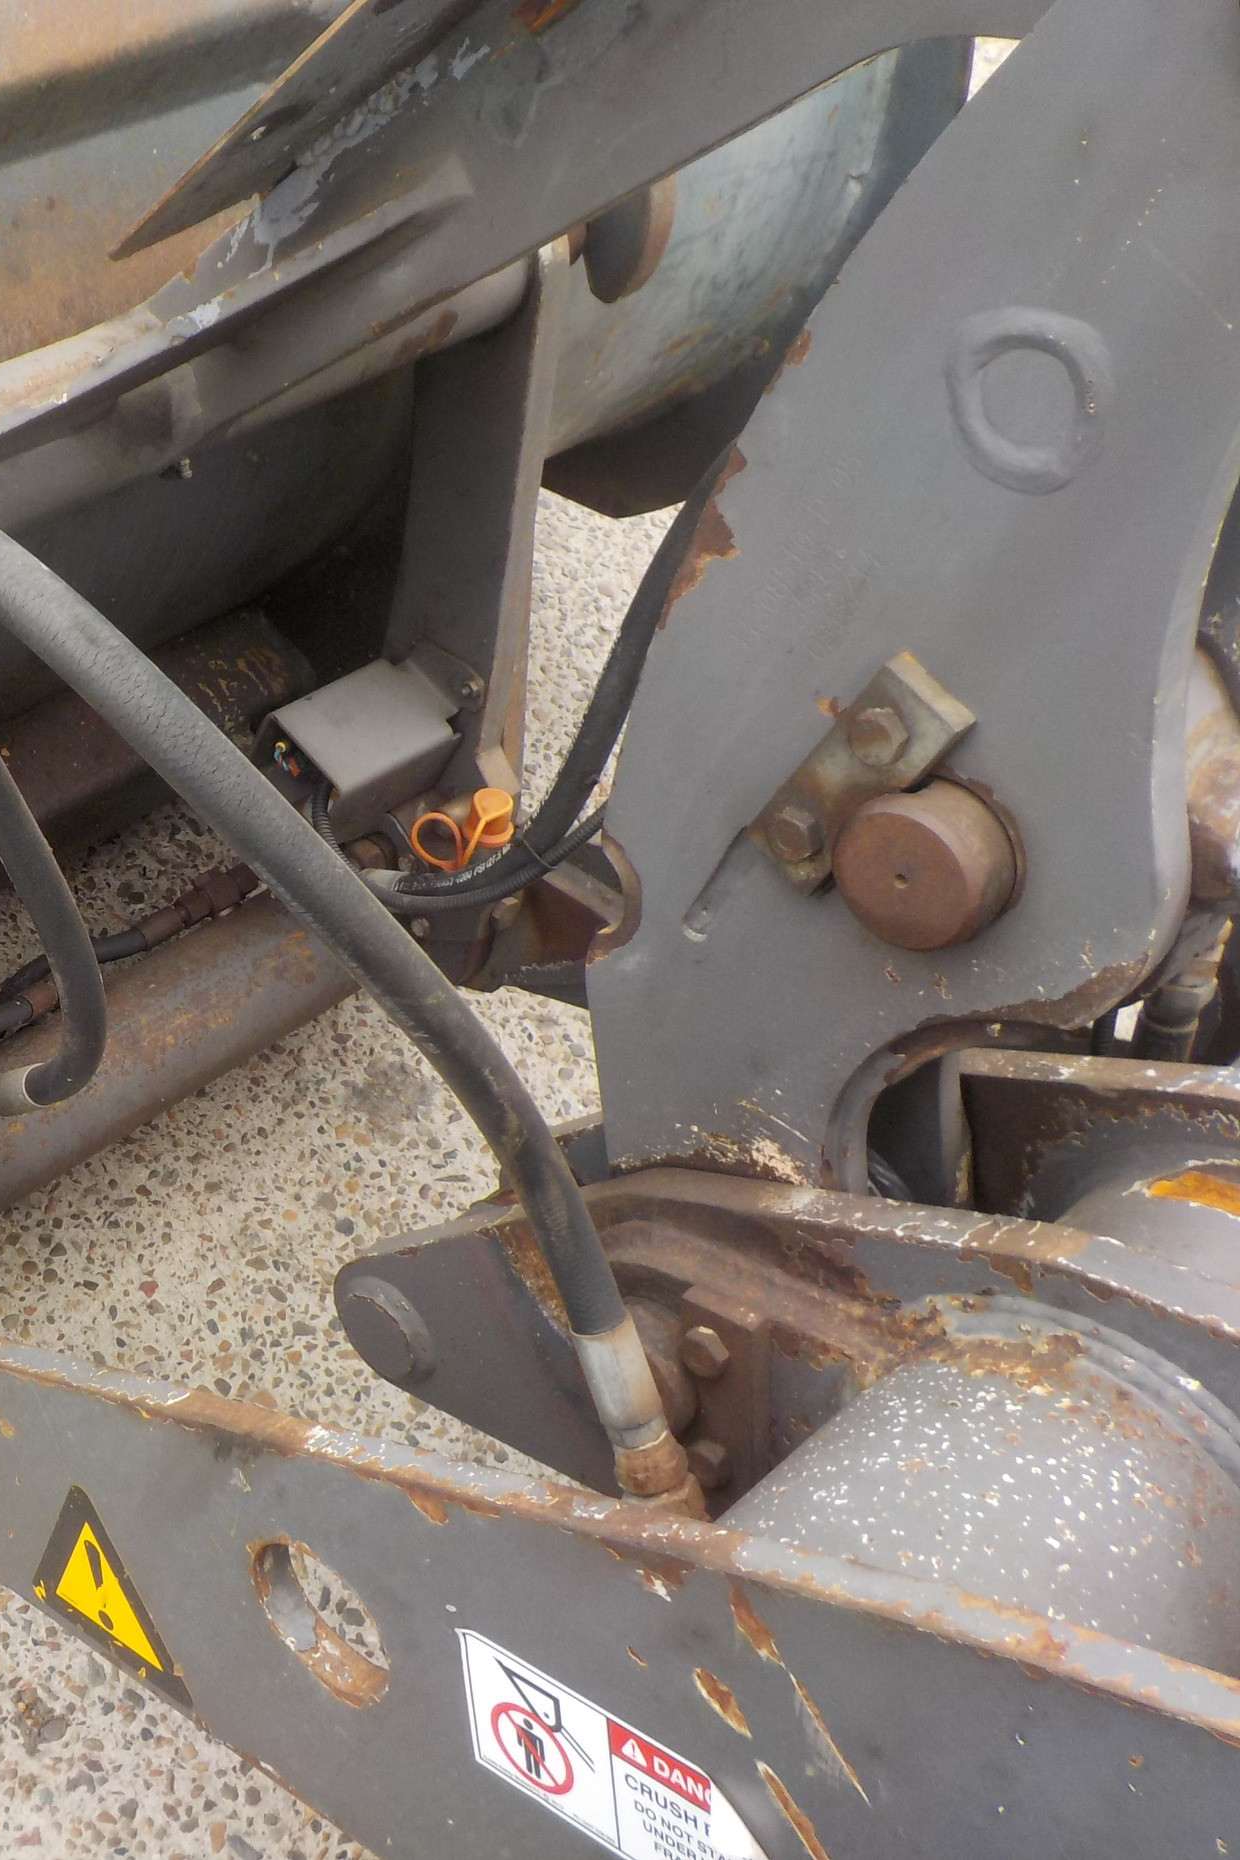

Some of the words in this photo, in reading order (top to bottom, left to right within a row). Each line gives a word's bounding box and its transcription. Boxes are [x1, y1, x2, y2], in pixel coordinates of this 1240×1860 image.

[624, 1773, 699, 1830] CRUSH
[634, 1799, 657, 1822] DO
[660, 1816, 694, 1844] NOT
